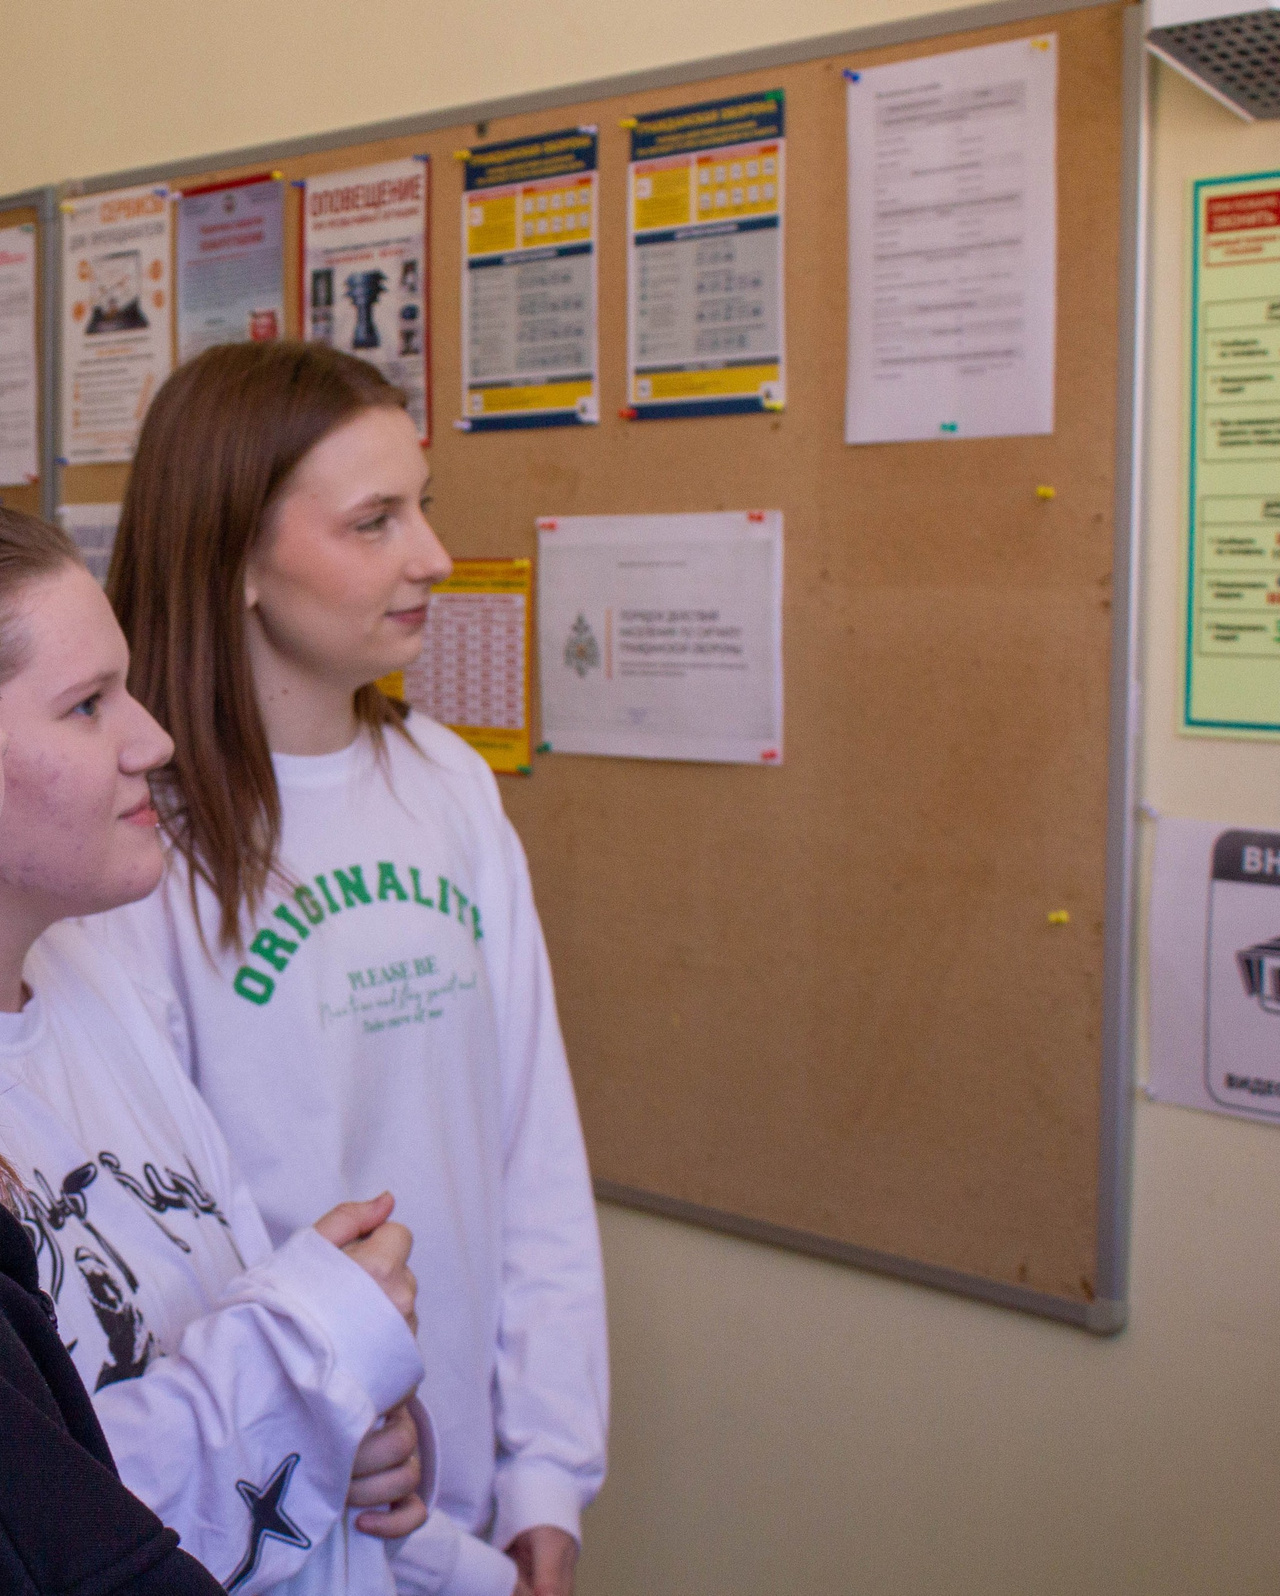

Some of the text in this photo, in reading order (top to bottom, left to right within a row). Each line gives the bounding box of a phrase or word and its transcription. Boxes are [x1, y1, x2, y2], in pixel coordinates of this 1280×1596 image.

[312, 174, 421, 216] ОПОВЕЩЕНИЕ
[347, 955, 439, 991] PLEASE BE
